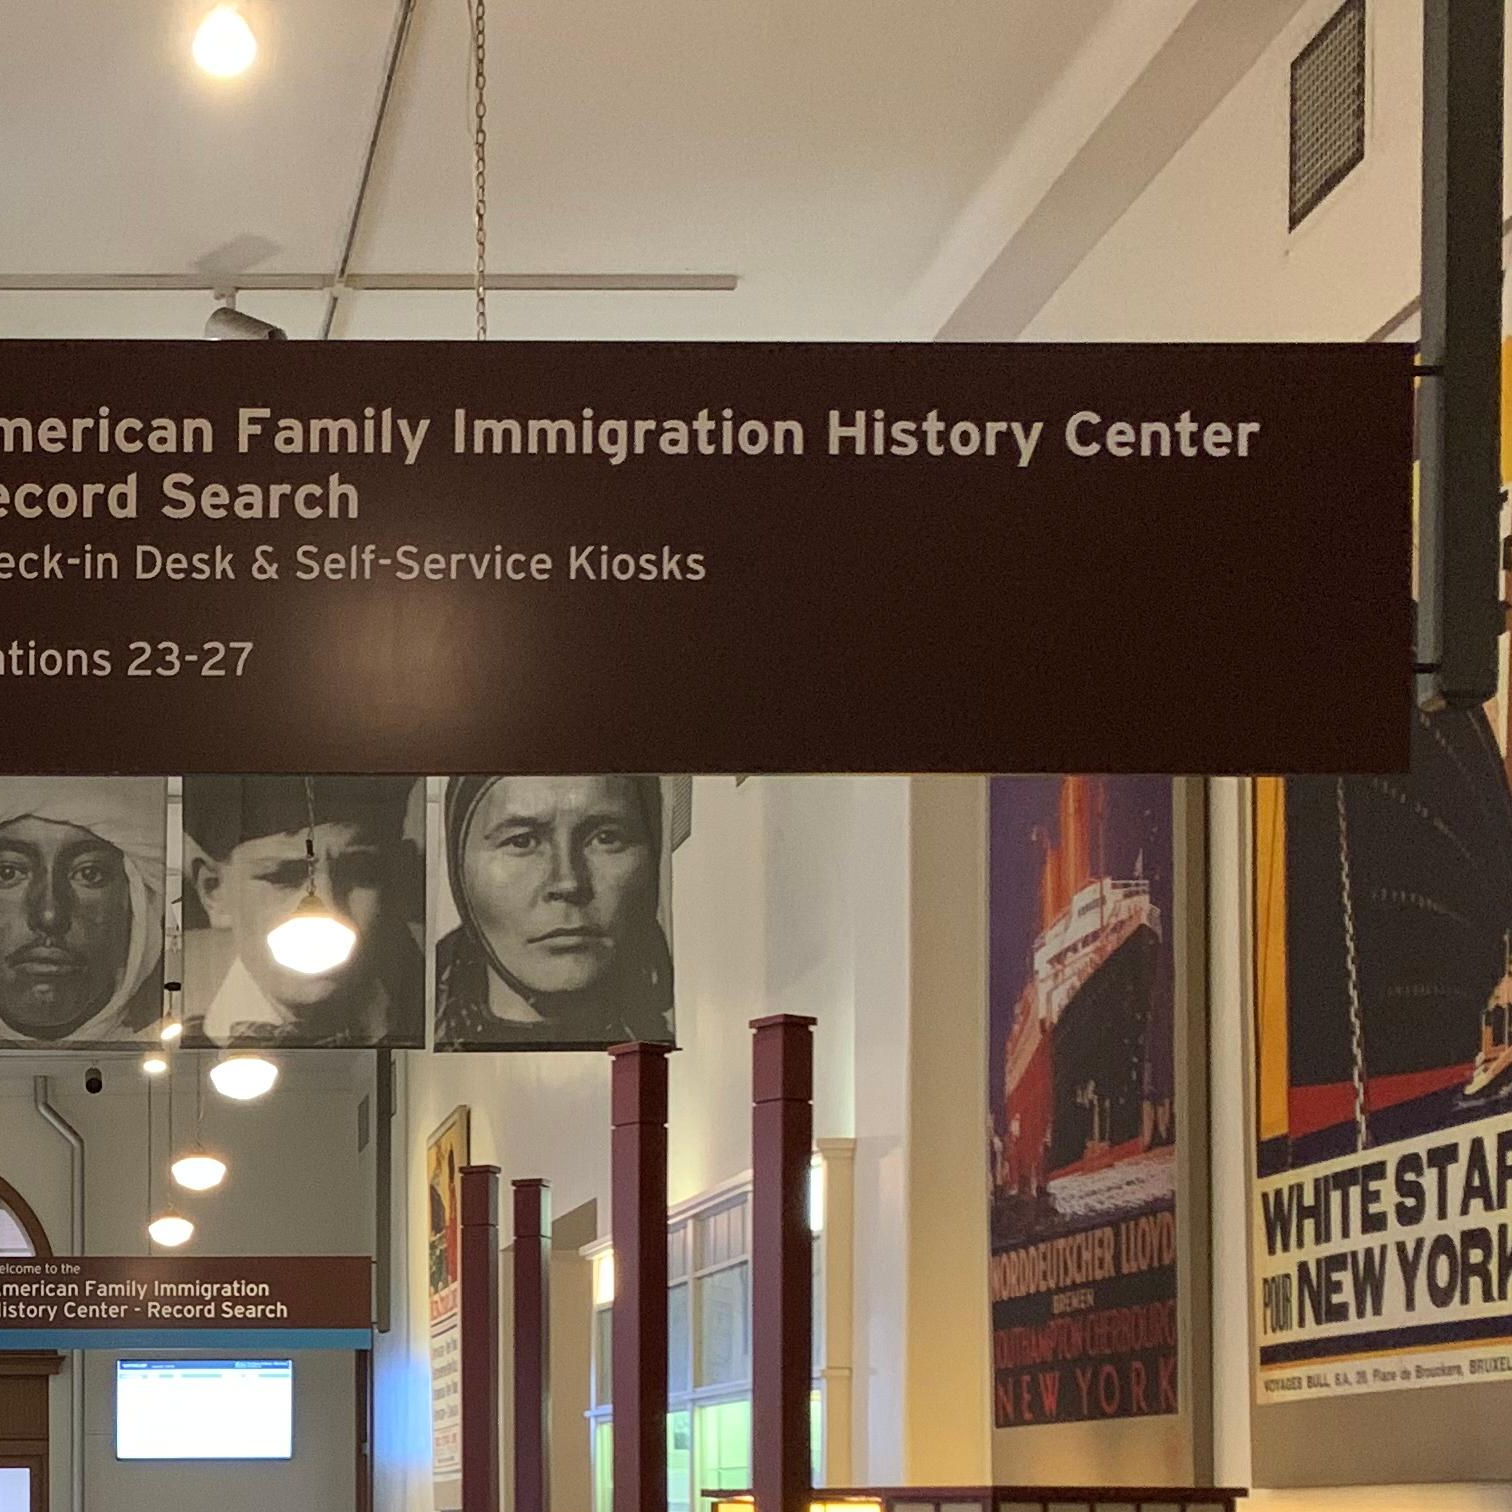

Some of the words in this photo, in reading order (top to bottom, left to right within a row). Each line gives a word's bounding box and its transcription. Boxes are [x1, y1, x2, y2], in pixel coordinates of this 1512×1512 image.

[237, 406, 431, 465] Family
[454, 407, 804, 466] Immigration
[828, 408, 1044, 467] History
[1065, 410, 1261, 458] Center
[161, 472, 359, 519] Search
[135, 544, 236, 580] Desk
[251, 544, 279, 580] &
[295, 543, 553, 581] Self-Service
[569, 544, 706, 581] Kiosks
[127, 641, 254, 677] 23-27
[1262, 1161, 1388, 1256] WHITE
[1121, 1211, 1176, 1274] LLOYD
[45, 1263, 58, 1274] to
[61, 1263, 81, 1274] the
[85, 1279, 148, 1301] Family
[154, 1279, 270, 1301] Immigration
[1262, 1273, 1293, 1336] POUR
[1297, 1243, 1388, 1329] NEW
[63, 1301, 129, 1318] Center
[147, 1301, 215, 1318] Record
[221, 1301, 288, 1318] Search
[997, 1371, 1060, 1425] NEW
